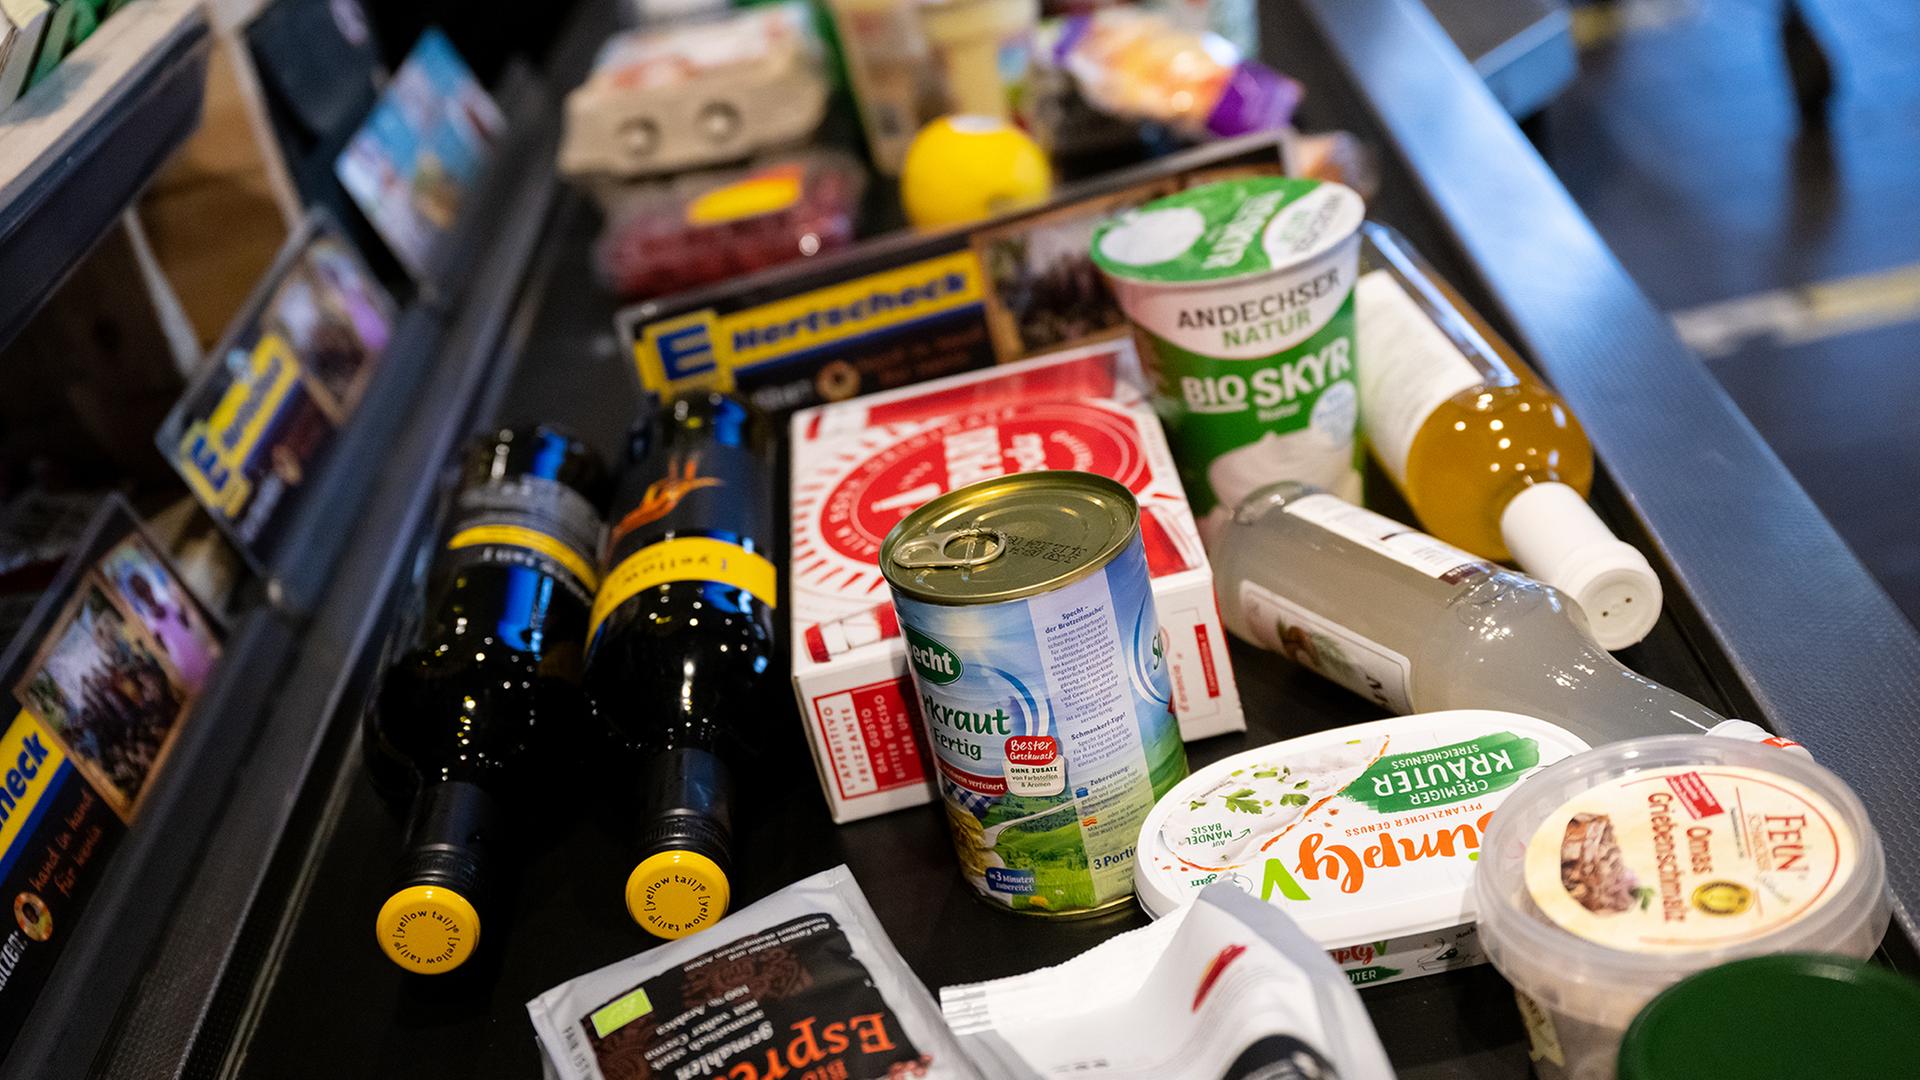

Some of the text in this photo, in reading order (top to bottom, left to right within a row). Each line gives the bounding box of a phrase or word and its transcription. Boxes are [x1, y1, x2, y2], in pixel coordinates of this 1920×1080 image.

[1177, 266, 1340, 331] ANDECHSER
[1222, 308, 1313, 350] NATUR
[1182, 337, 1351, 408] BIO SKYR
[1045, 604, 1104, 634] der Brotzeitmacher
[1061, 605, 1083, 621] Specht
[910, 643, 955, 675] echt
[920, 692, 1014, 740] rkraut
[933, 727, 983, 761] Fertig
[1008, 749, 1055, 761] Geschmack
[1009, 738, 1053, 751] Bester
[1390, 743, 1479, 769] STREICHGENUSS
[0, 730, 49, 828] heck
[1009, 766, 1029, 774] OHNE
[1369, 747, 1514, 798] KRÄUTER
[1408, 778, 1489, 805] CREMIGER
[1190, 822, 1222, 834] BASIS
[1343, 801, 1482, 837] PFLANZLICHER GENUSS
[1184, 829, 1232, 845] MANDEL
[1685, 823, 1717, 875] Omas
[1092, 857, 1101, 870] 3
[1251, 802, 1499, 909] implyV
[1647, 790, 1690, 923] Griebenschmalz
[994, 870, 1002, 881] 3
[1188, 873, 1218, 887] gan
[1349, 968, 1376, 983] UTER
[723, 983, 750, 1002] 100
[731, 997, 759, 1017] mit
[654, 1003, 707, 1037] Arabica
[690, 1009, 731, 1037] voller
[649, 1008, 765, 1073] aromatisch stark
[673, 1019, 776, 1080] gemahlen
[724, 1000, 896, 1080] Espre
